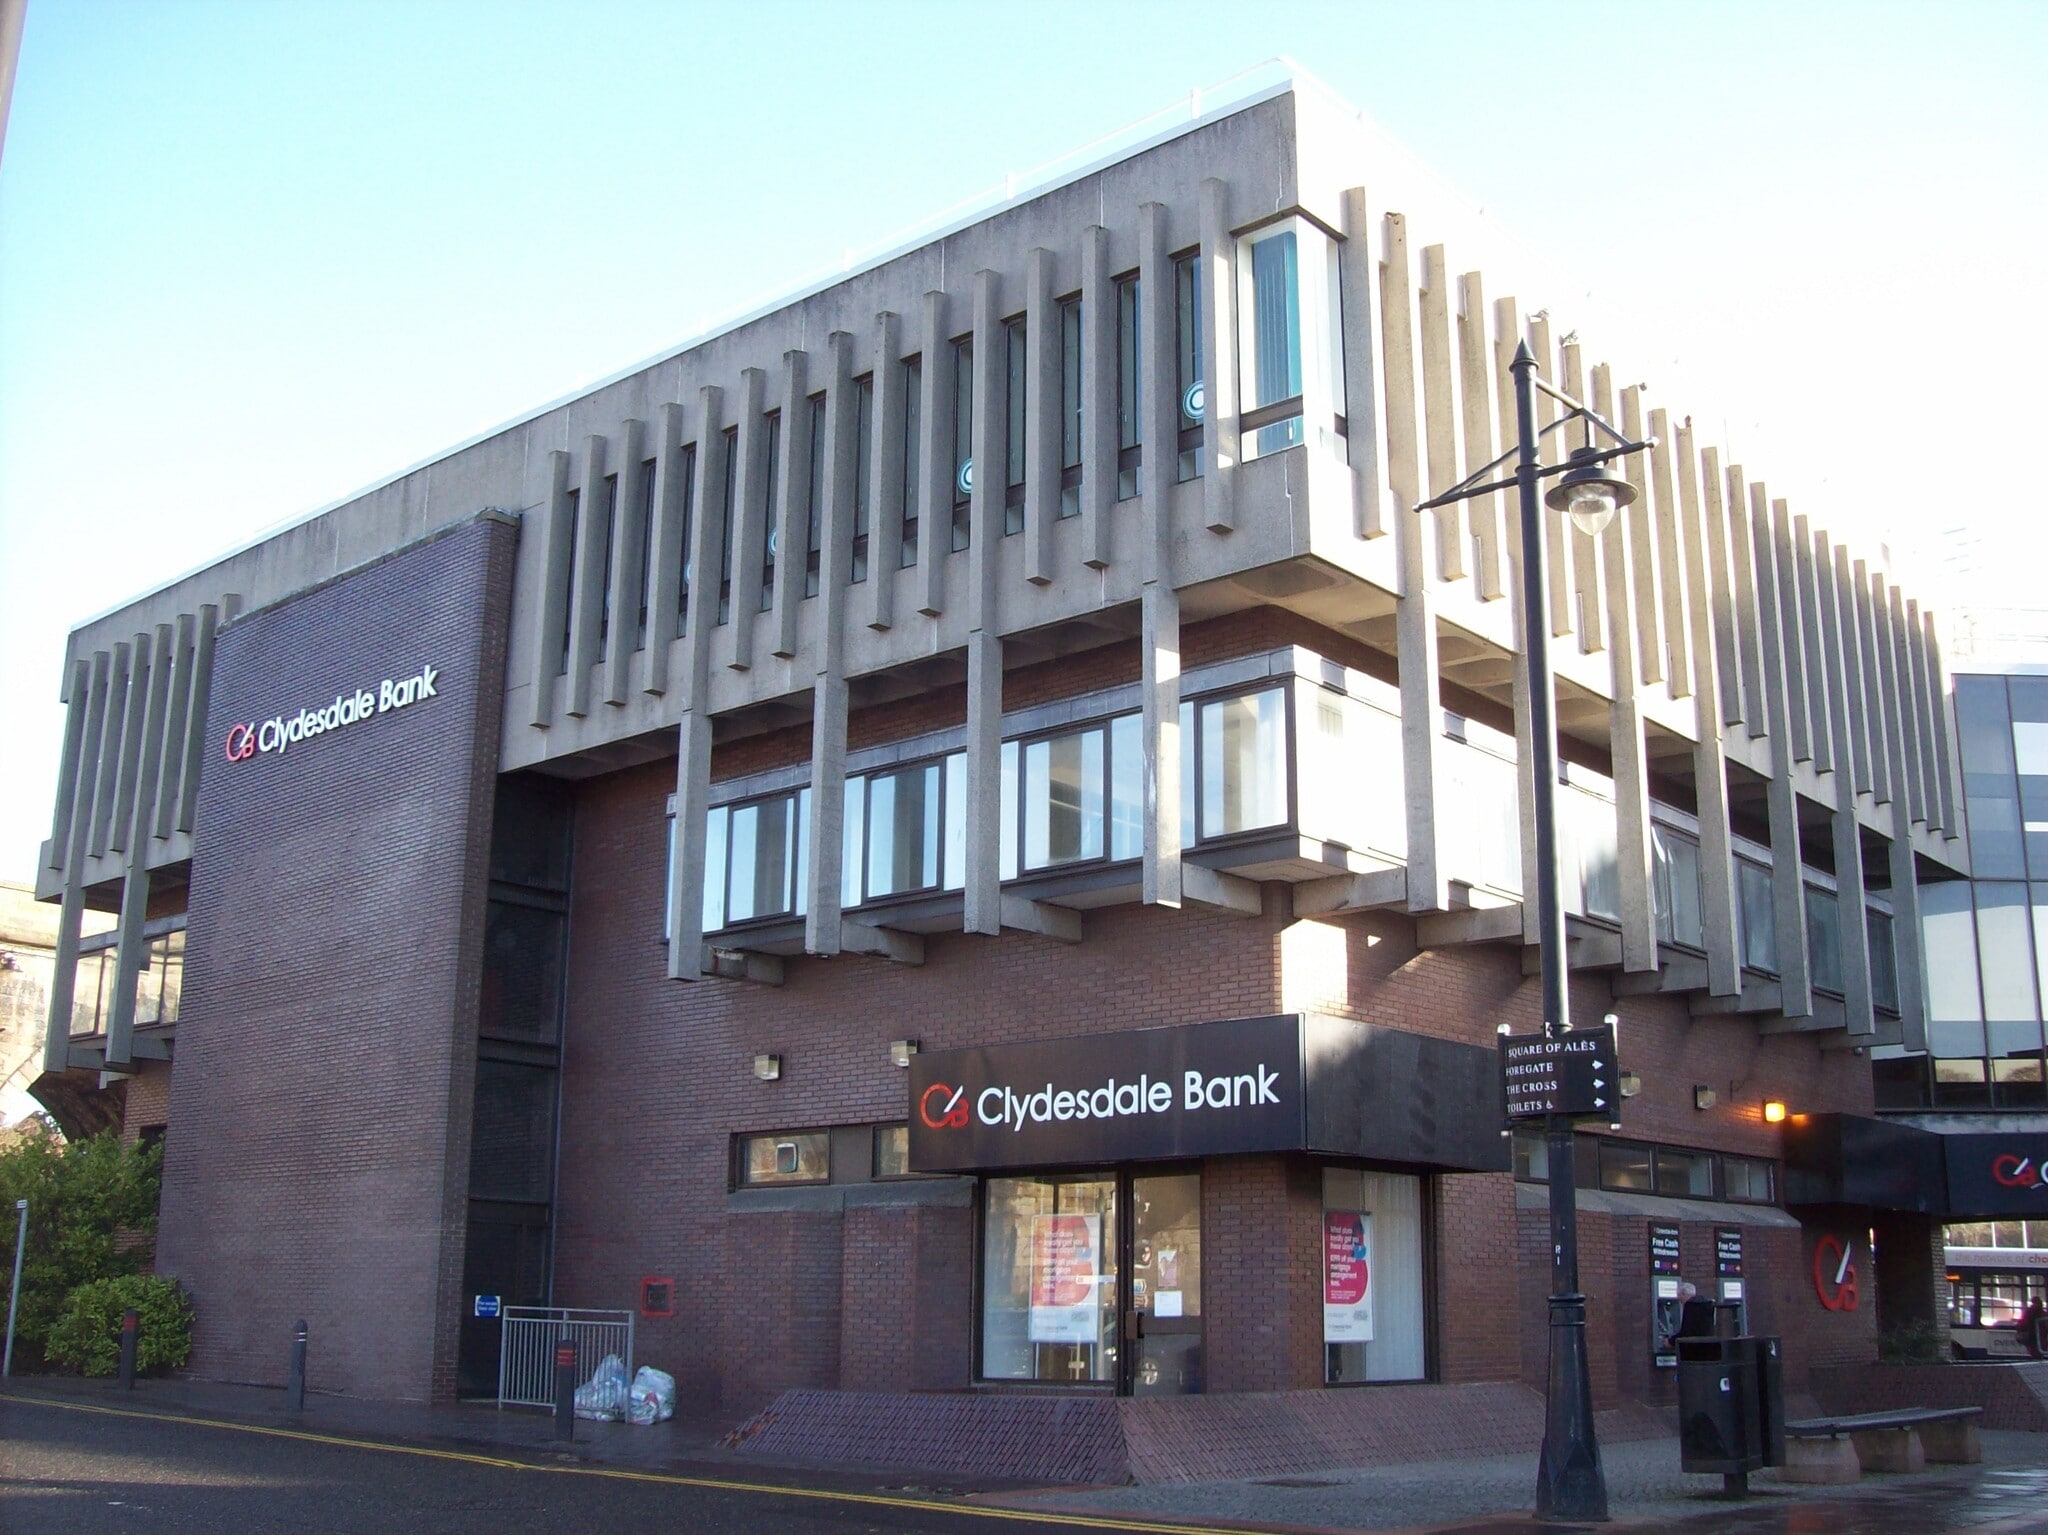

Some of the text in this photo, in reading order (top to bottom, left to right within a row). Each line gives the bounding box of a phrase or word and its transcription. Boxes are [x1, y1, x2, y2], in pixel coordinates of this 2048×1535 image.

[258, 689, 375, 753] Clydesdale
[379, 664, 438, 712] Bank
[1508, 1045, 1542, 1058] SQUARE
[1545, 1043, 1561, 1053] OF
[1505, 1062, 1553, 1076] FOREGATE
[1506, 1080, 1557, 1095] THE CROSS
[977, 1074, 1172, 1132] Clydesdale
[1184, 1063, 1281, 1111] Bank
[1507, 1101, 1542, 1113] TOILETS
